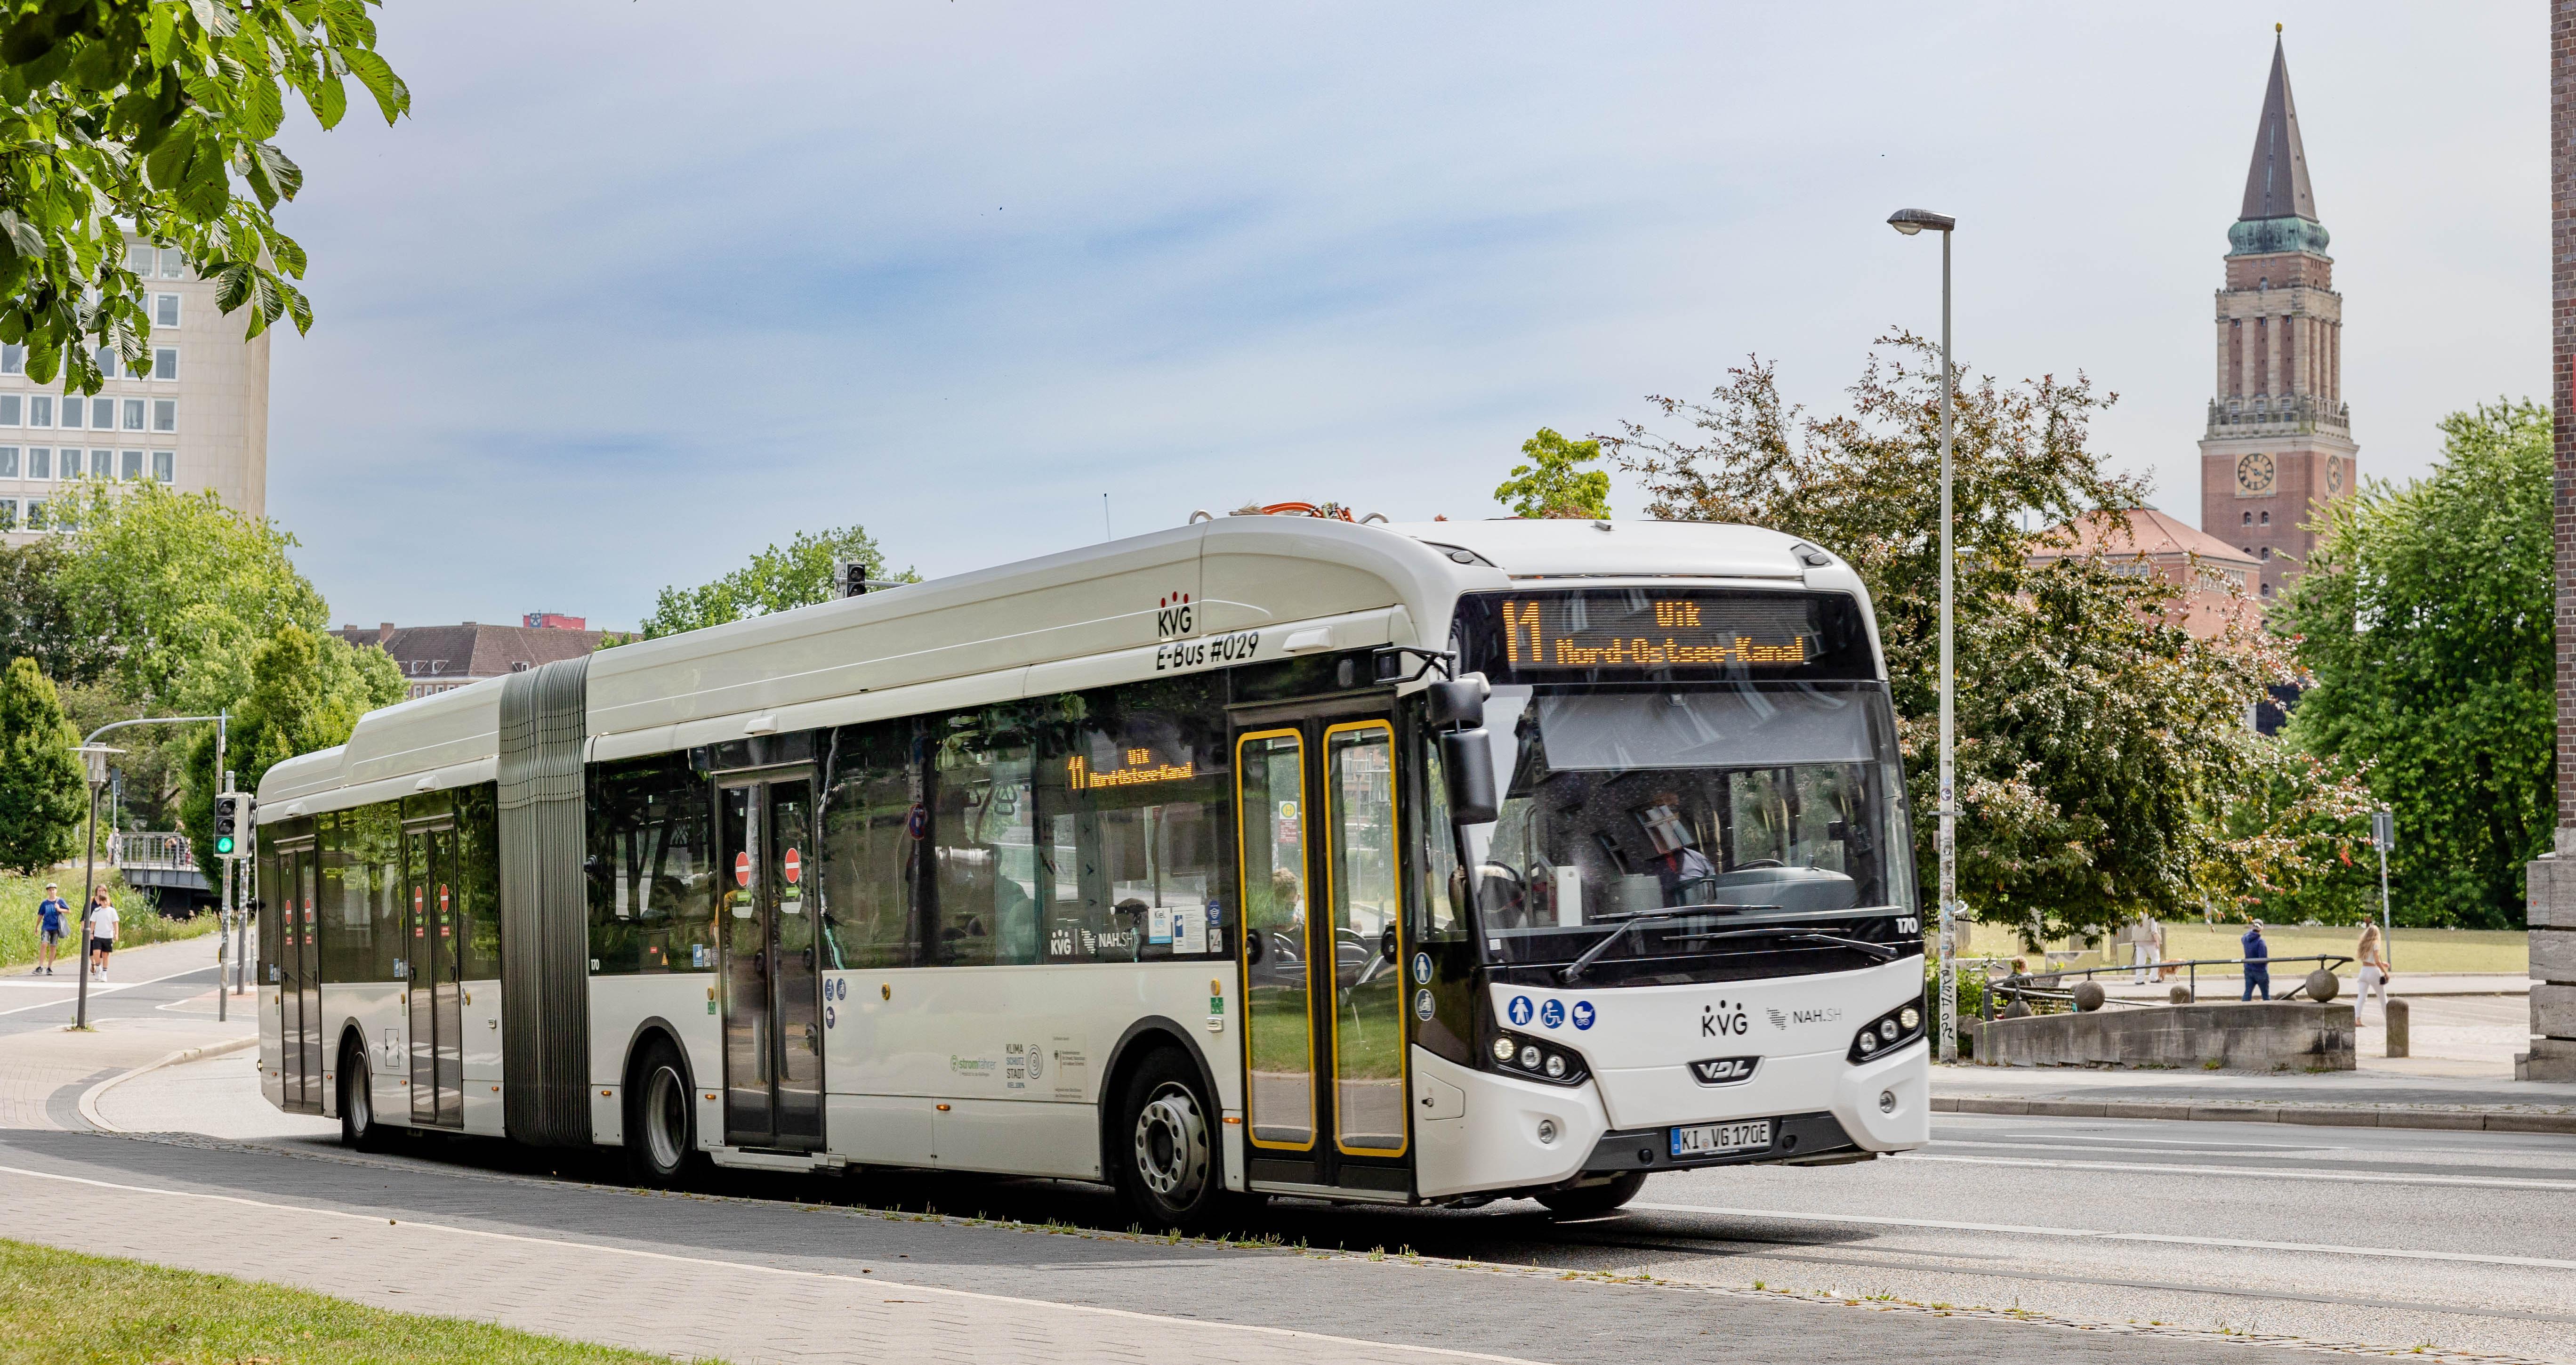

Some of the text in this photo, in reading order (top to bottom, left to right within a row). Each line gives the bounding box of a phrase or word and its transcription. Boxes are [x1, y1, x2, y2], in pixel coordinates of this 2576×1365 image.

[1158, 606, 1191, 637] KVG
[1656, 601, 1701, 627] Wik
[1210, 631, 1259, 662] #029
[1555, 637, 1804, 664] Nord-Ostsee-Kanal
[1067, 756, 1085, 790] 11
[1895, 917, 1918, 934] 170
[1050, 932, 1133, 955] KVG NAH.SH
[590, 959, 600, 970] 170
[1701, 1007, 1842, 1037] KVG NAH.SH
[1006, 1068, 1024, 1079] STADT
[1698, 1060, 1750, 1079] VDL
[1682, 1124, 1768, 1150] KI VG 170E
